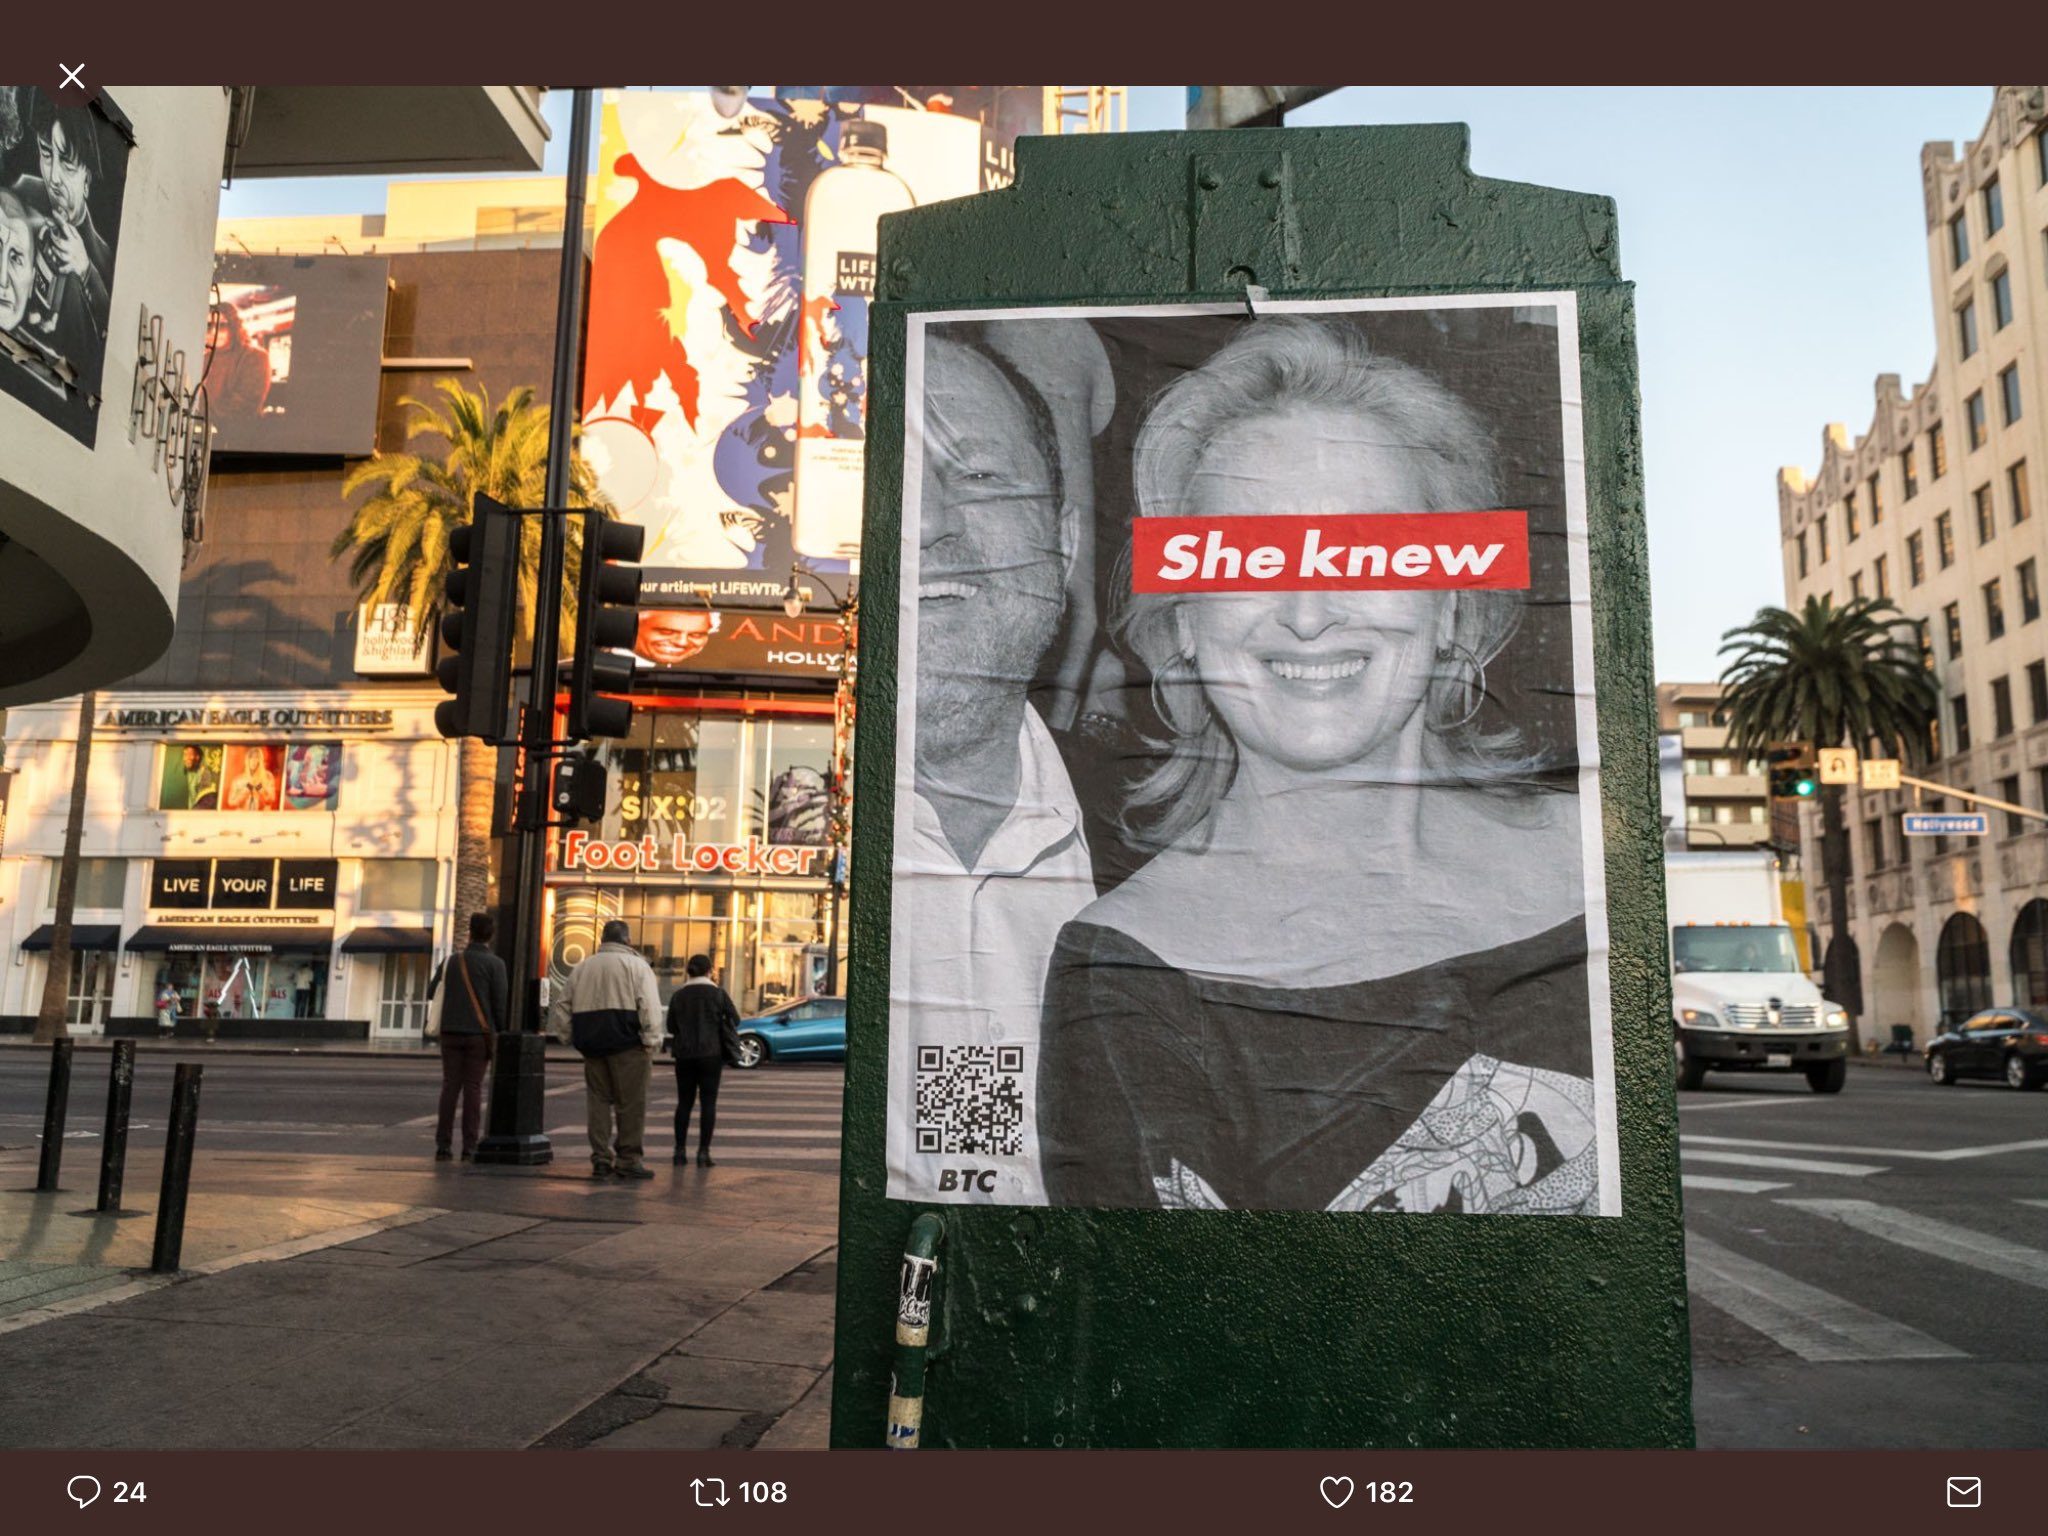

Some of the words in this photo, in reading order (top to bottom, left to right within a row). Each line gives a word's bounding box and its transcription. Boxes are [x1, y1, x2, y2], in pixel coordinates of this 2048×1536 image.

[1157, 530, 1286, 581] She
[1299, 529, 1505, 578] knew
[102, 709, 204, 727] AMERICAN
[207, 709, 270, 727] EAGLE
[274, 709, 393, 727] OUTFITTERS
[621, 795, 727, 821] SIX:02
[564, 830, 660, 870] Foot
[672, 832, 818, 875] Locker
[163, 878, 201, 893] LIVE
[221, 878, 267, 893] YOUR
[289, 877, 326, 892] LIFE
[157, 915, 214, 924] AMERICAN
[217, 915, 250, 924] EAGLE
[252, 915, 320, 924] OUTFITTERS
[168, 944, 205, 952] AMERICAN
[206, 944, 229, 952] EAGLE
[229, 944, 273, 952] OUTFITTERS
[938, 1169, 998, 1193] BTC
